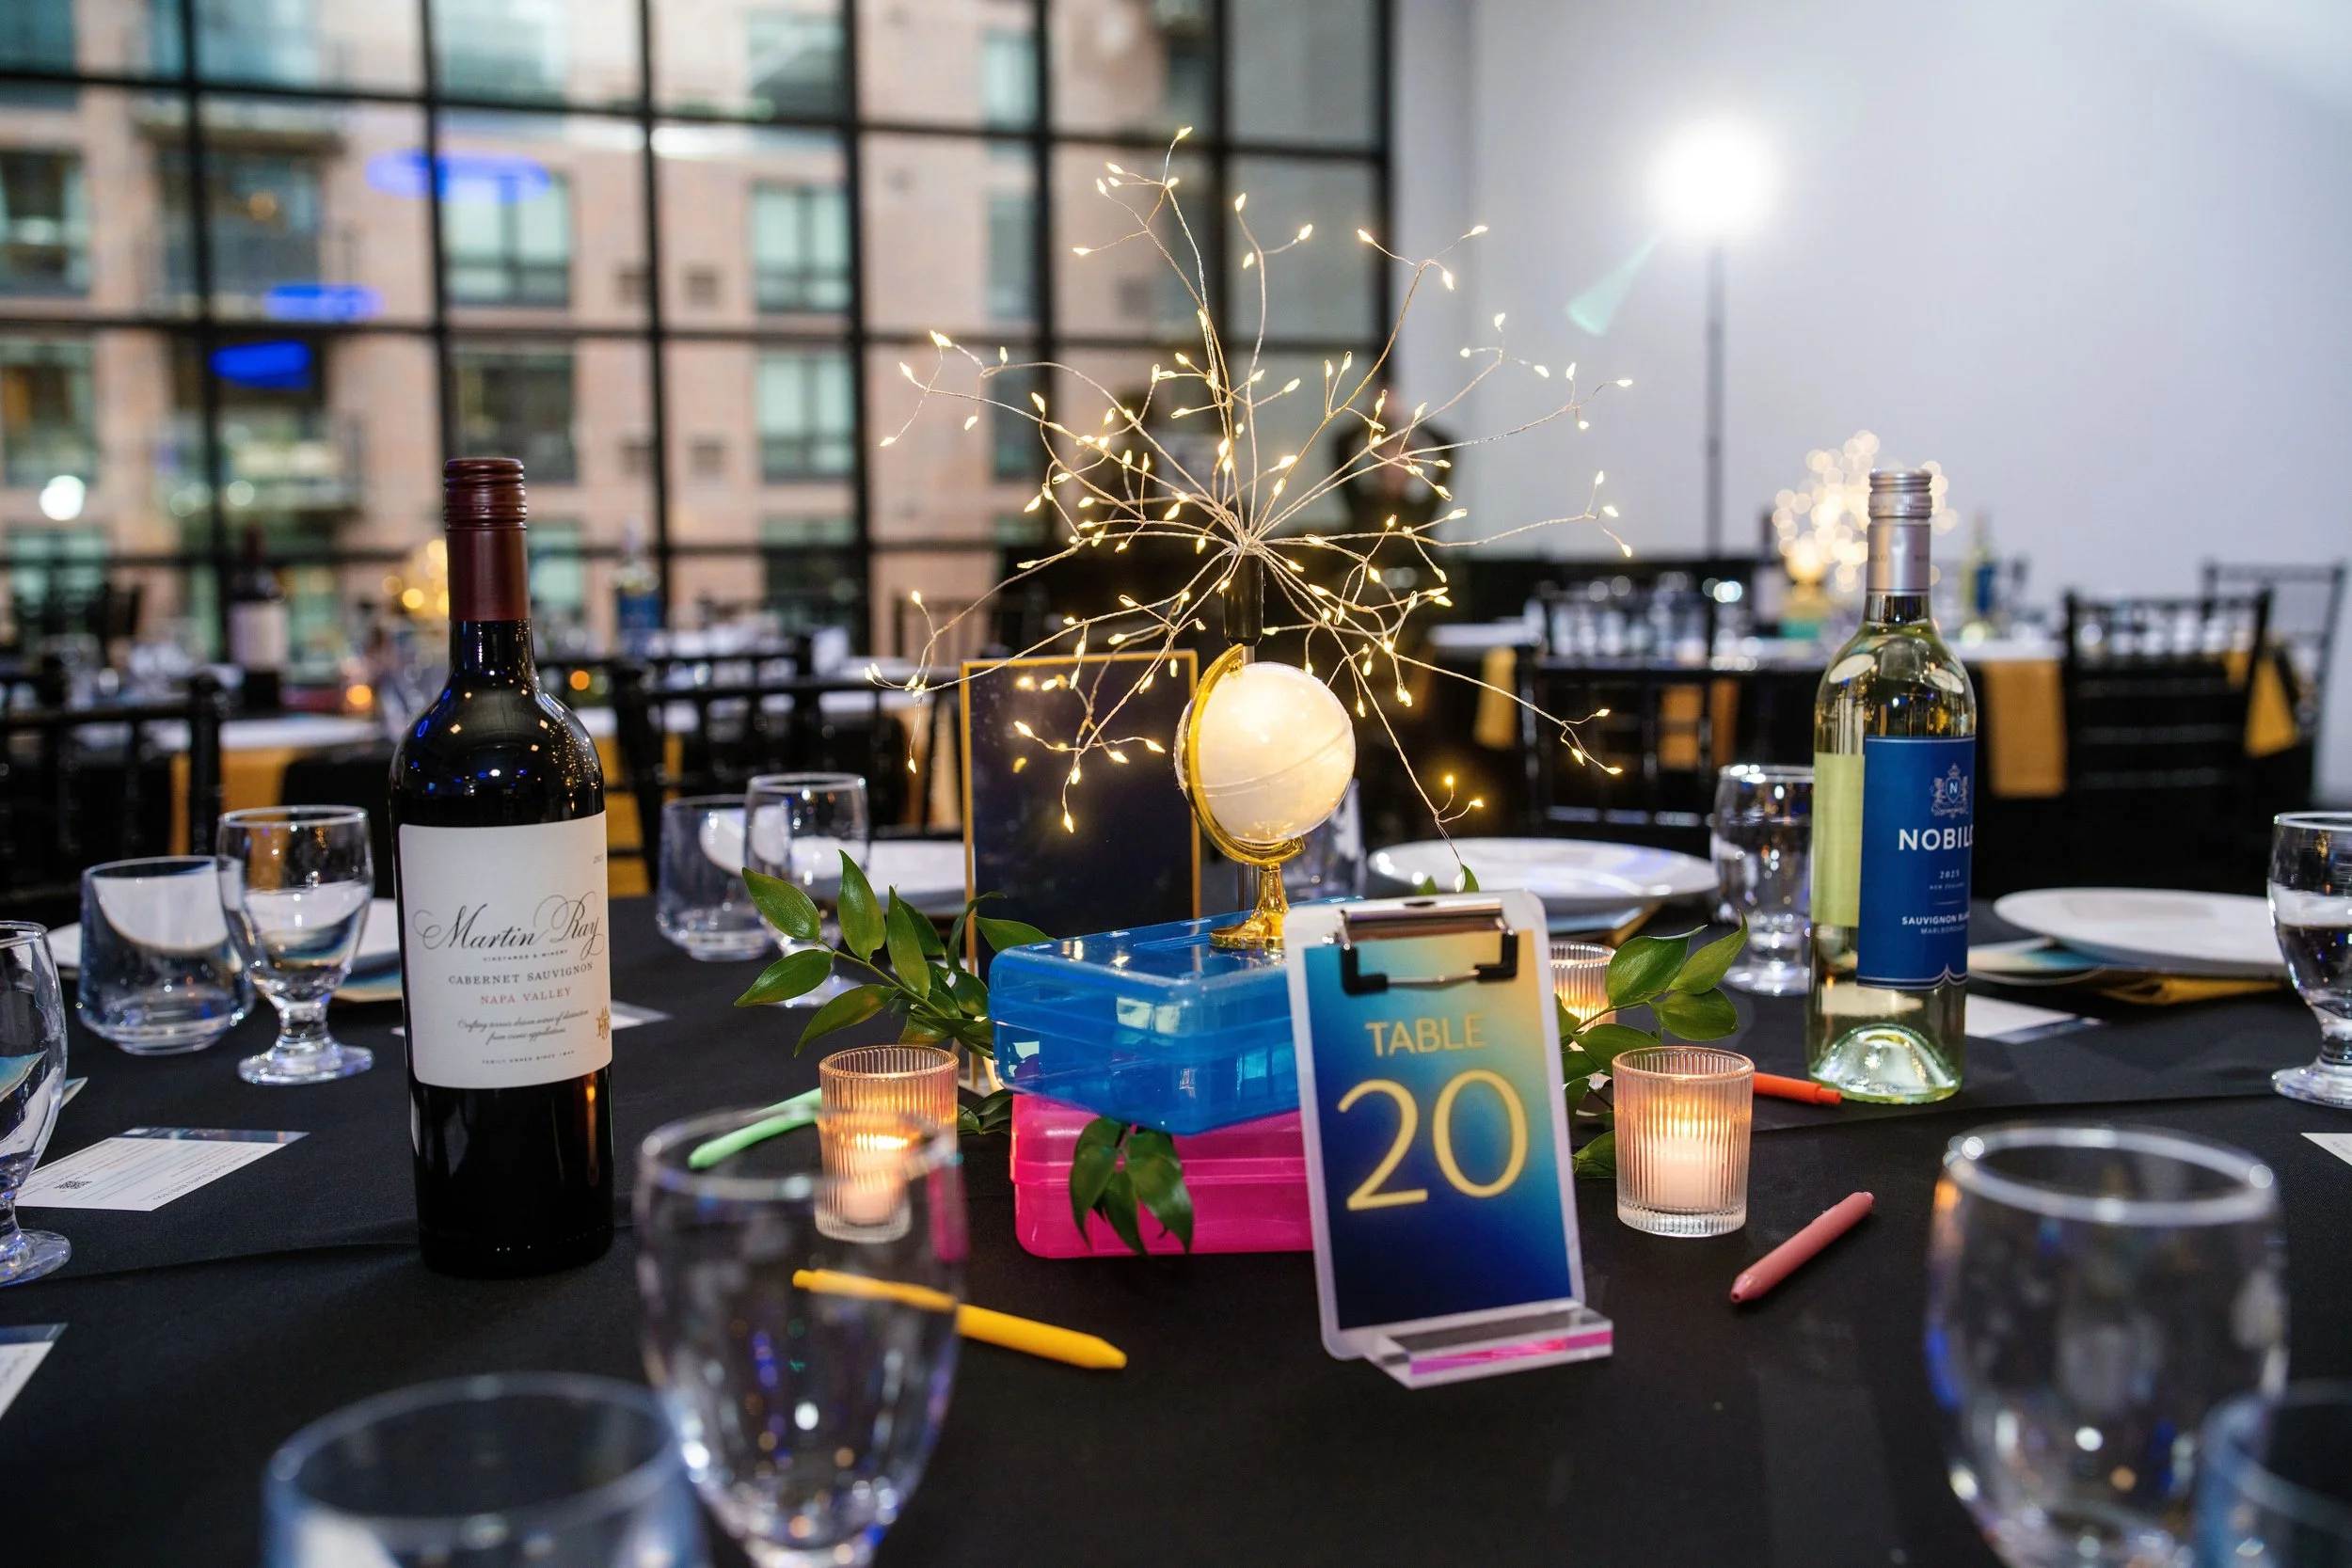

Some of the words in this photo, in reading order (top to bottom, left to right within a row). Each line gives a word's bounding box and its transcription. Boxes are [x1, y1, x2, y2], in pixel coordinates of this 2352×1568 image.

[1949, 782, 1958, 794] N
[413, 904, 548, 950] Martin
[533, 891, 605, 960] Ray
[1901, 914, 1957, 926] SAUVIGNON
[449, 974, 519, 986] CABERNET
[527, 962, 594, 982] SAUVIGNON
[481, 994, 516, 1005] NAPA
[523, 987, 571, 1002] VALLEY
[1365, 1012, 1488, 1057] TABLE
[1337, 1069, 1528, 1211] 20
